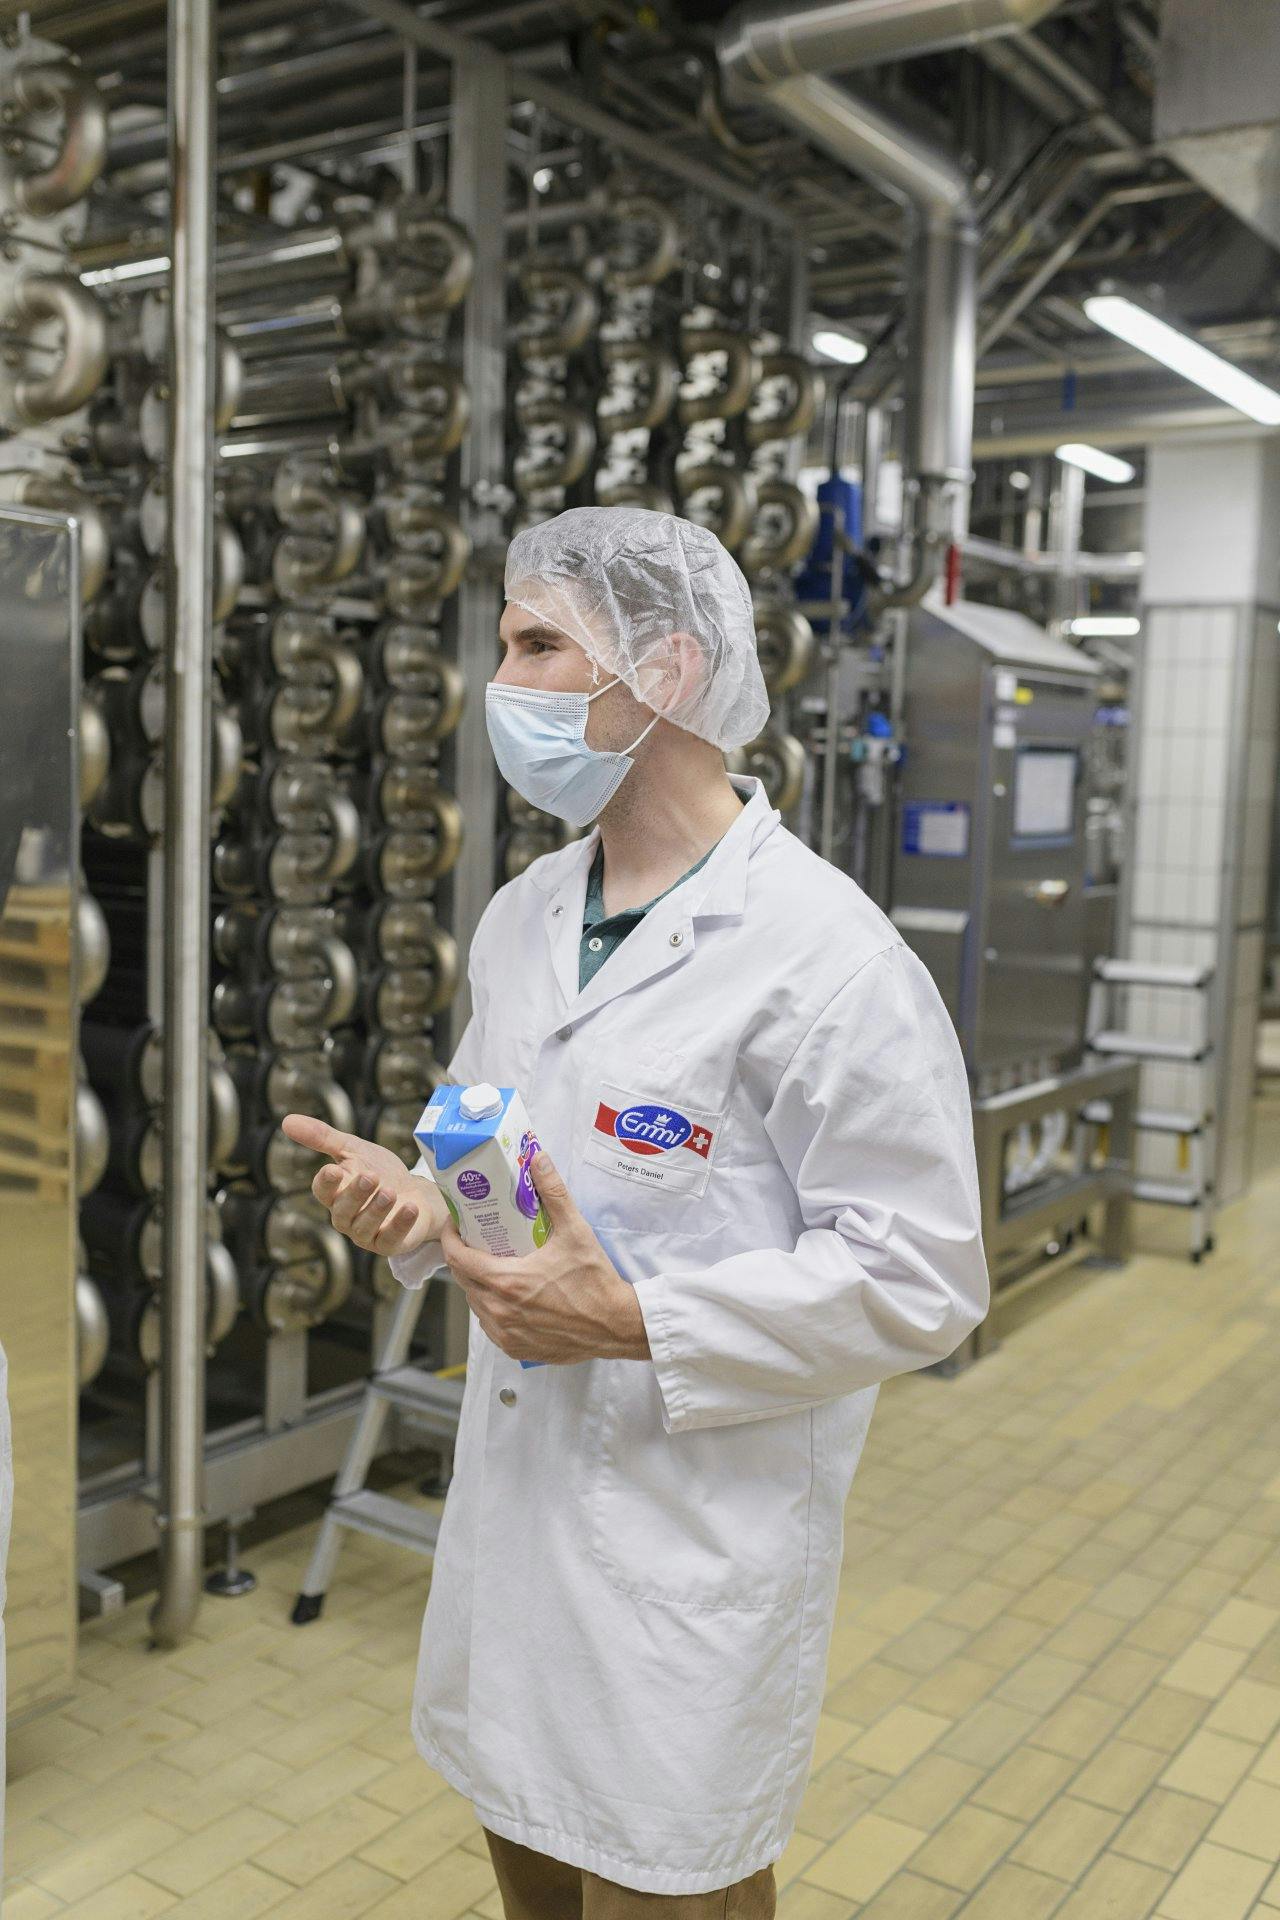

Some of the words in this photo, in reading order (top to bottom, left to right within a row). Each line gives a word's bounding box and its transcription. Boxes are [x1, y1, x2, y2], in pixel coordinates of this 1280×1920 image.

[621, 1111, 686, 1145] Emmi
[617, 1161, 639, 1173] Peters
[640, 1168, 664, 1180] Daniel
